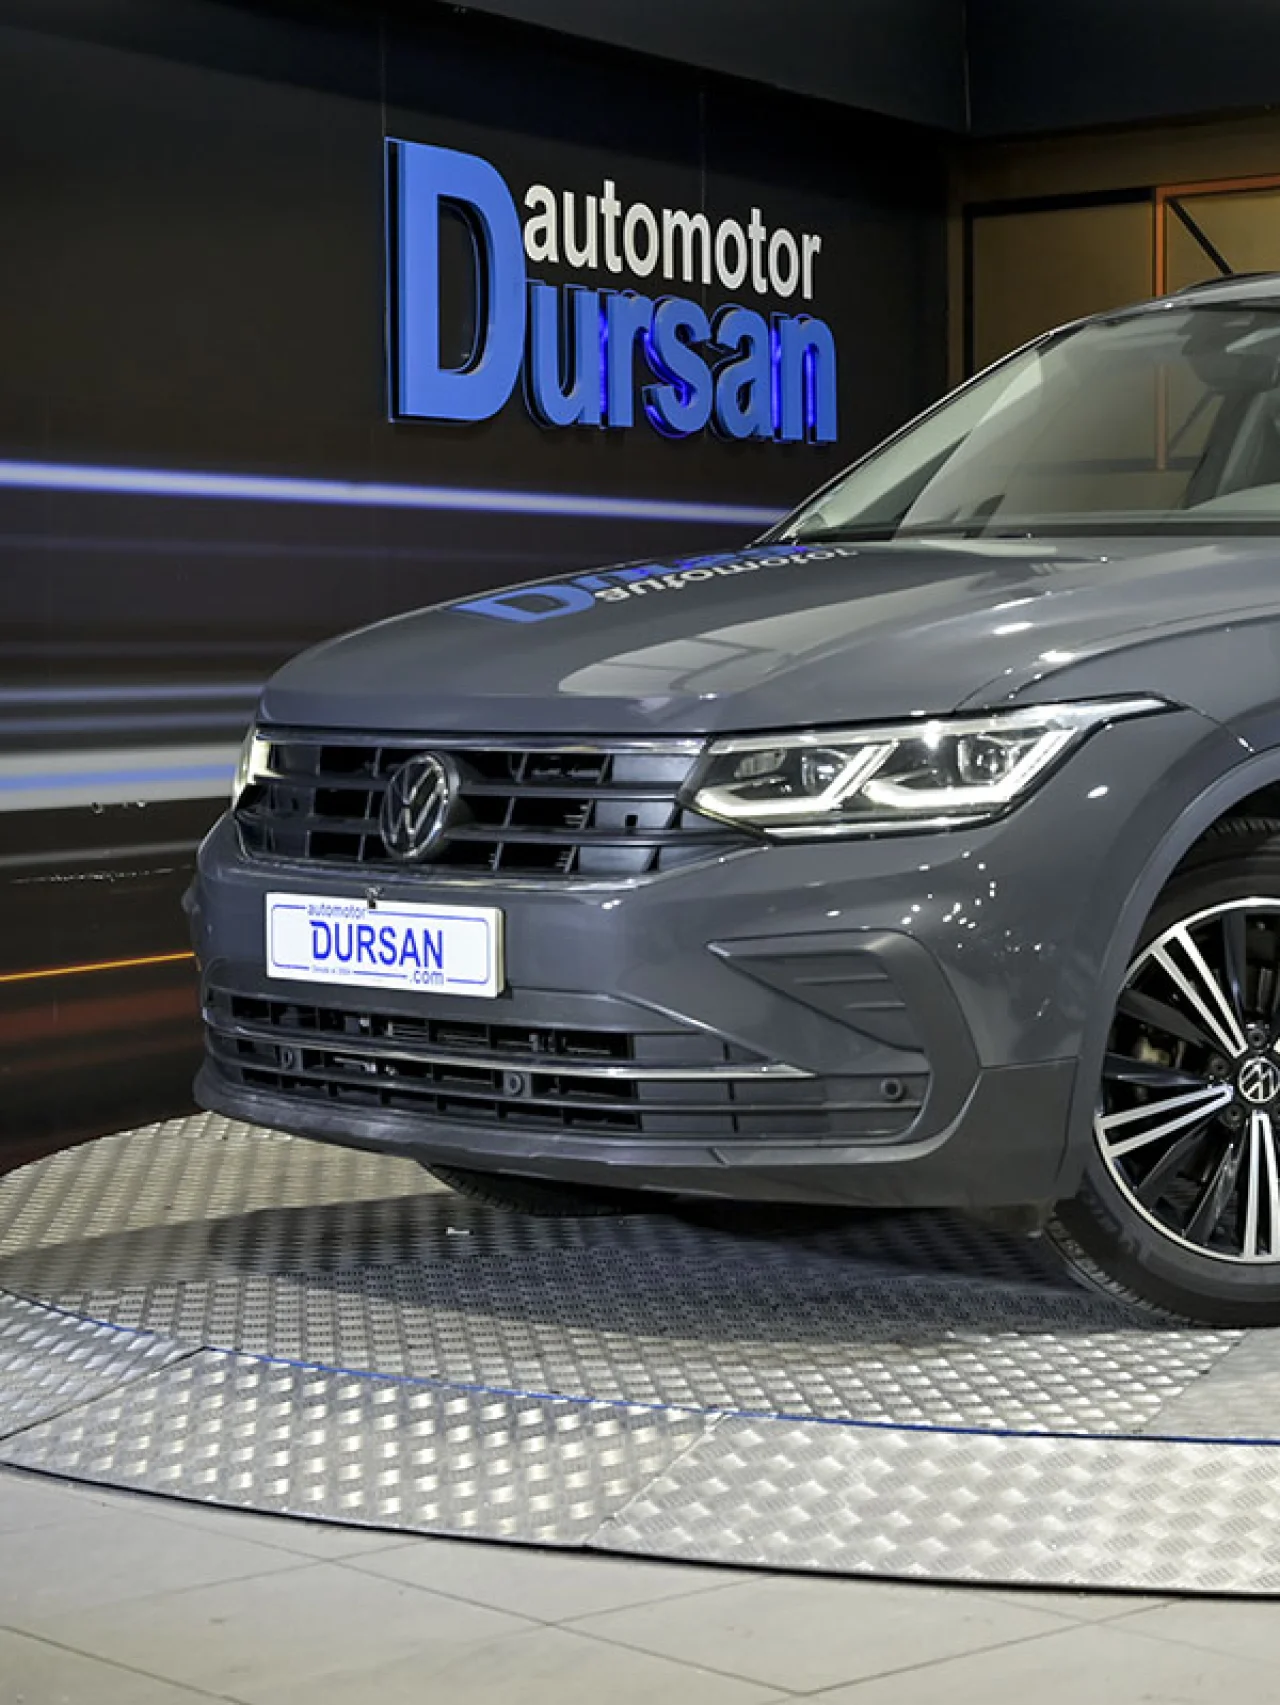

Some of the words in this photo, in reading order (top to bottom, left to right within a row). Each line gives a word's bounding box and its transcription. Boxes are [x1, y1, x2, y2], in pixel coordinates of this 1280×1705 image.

[523, 179, 822, 299] automotor
[384, 137, 837, 444] Dursan
[307, 902, 367, 920] automotor
[309, 919, 444, 970] DURSAN
[409, 969, 445, 985] .com
